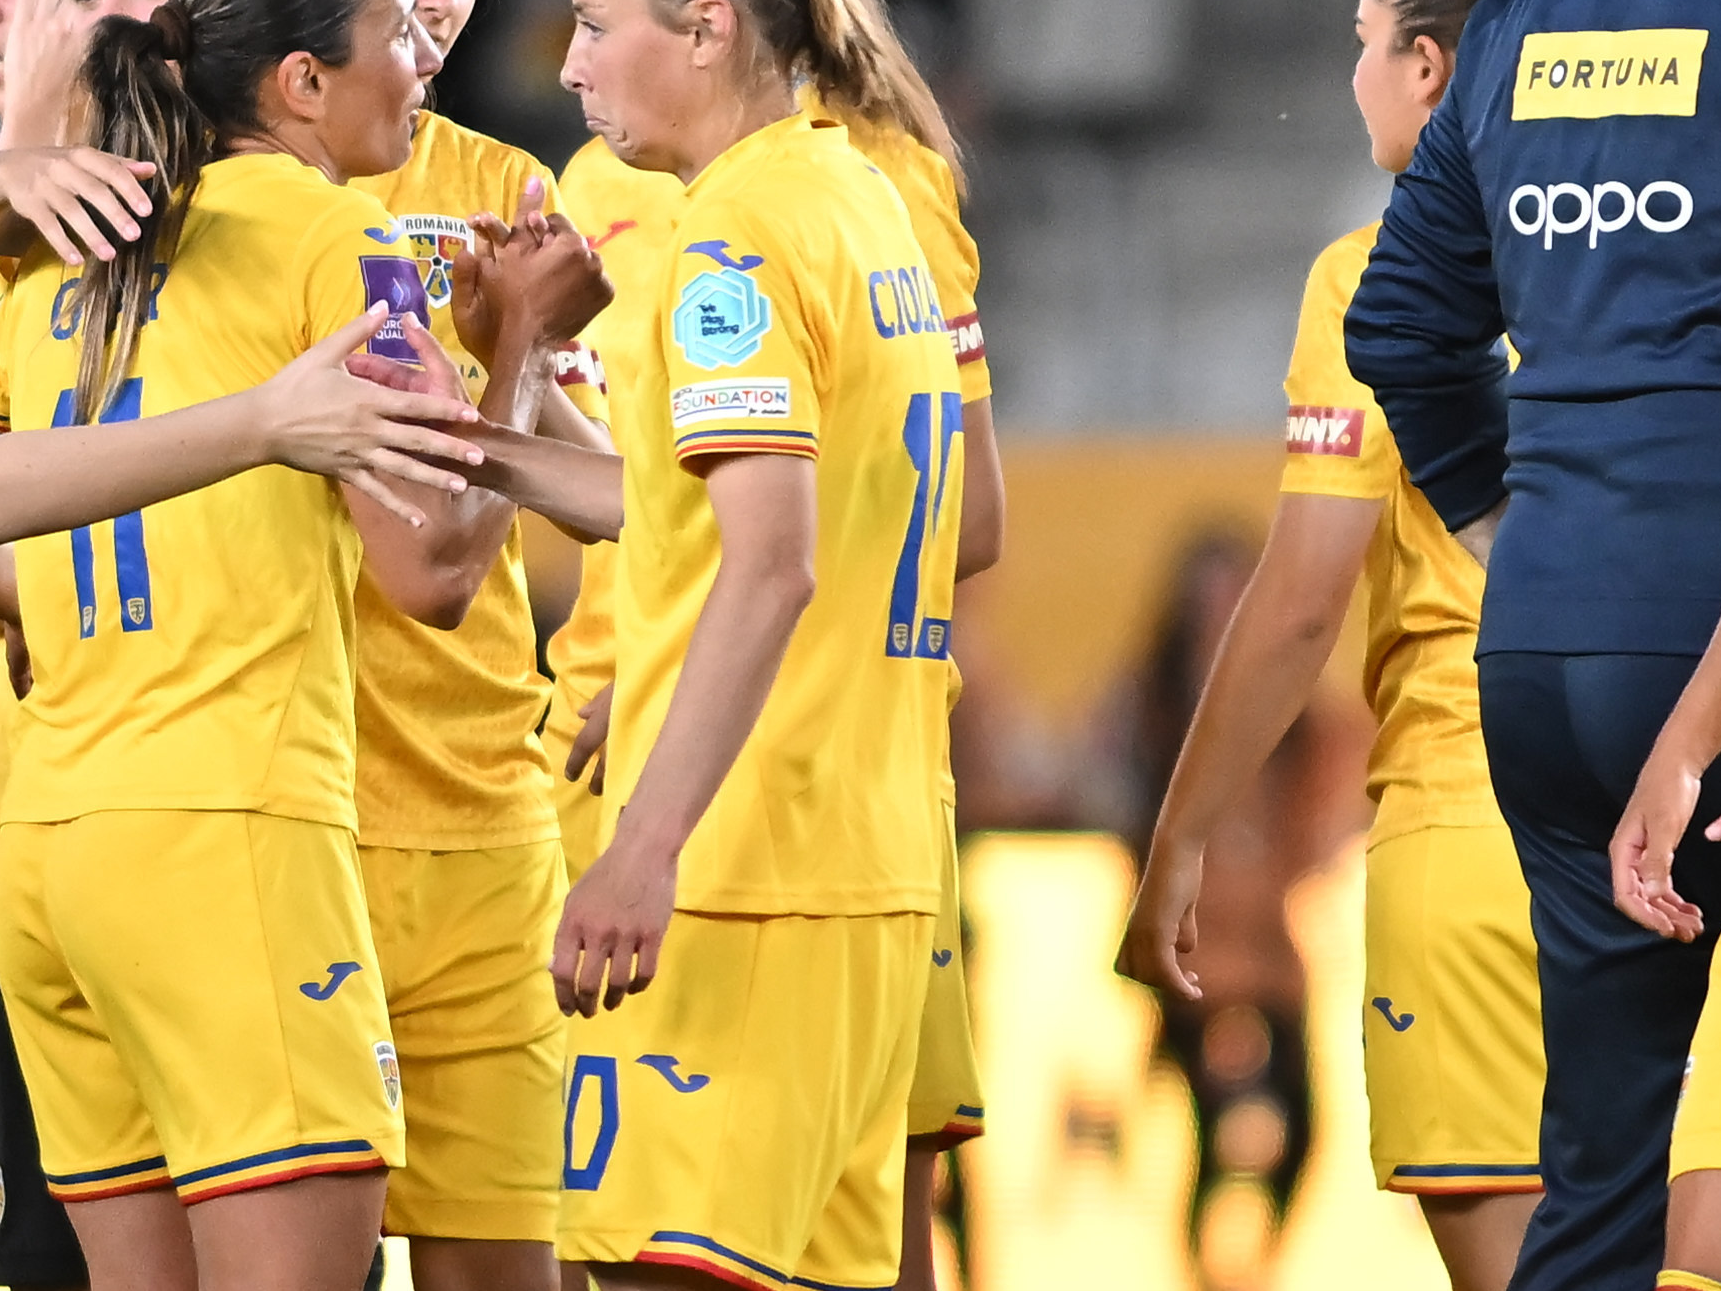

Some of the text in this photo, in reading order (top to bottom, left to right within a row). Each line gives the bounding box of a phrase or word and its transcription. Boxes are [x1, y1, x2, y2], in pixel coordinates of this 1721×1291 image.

[1528, 56, 1680, 90] FORTUNA
[1509, 180, 1694, 250] oppo
[673, 391, 788, 413] FOUNDATION
